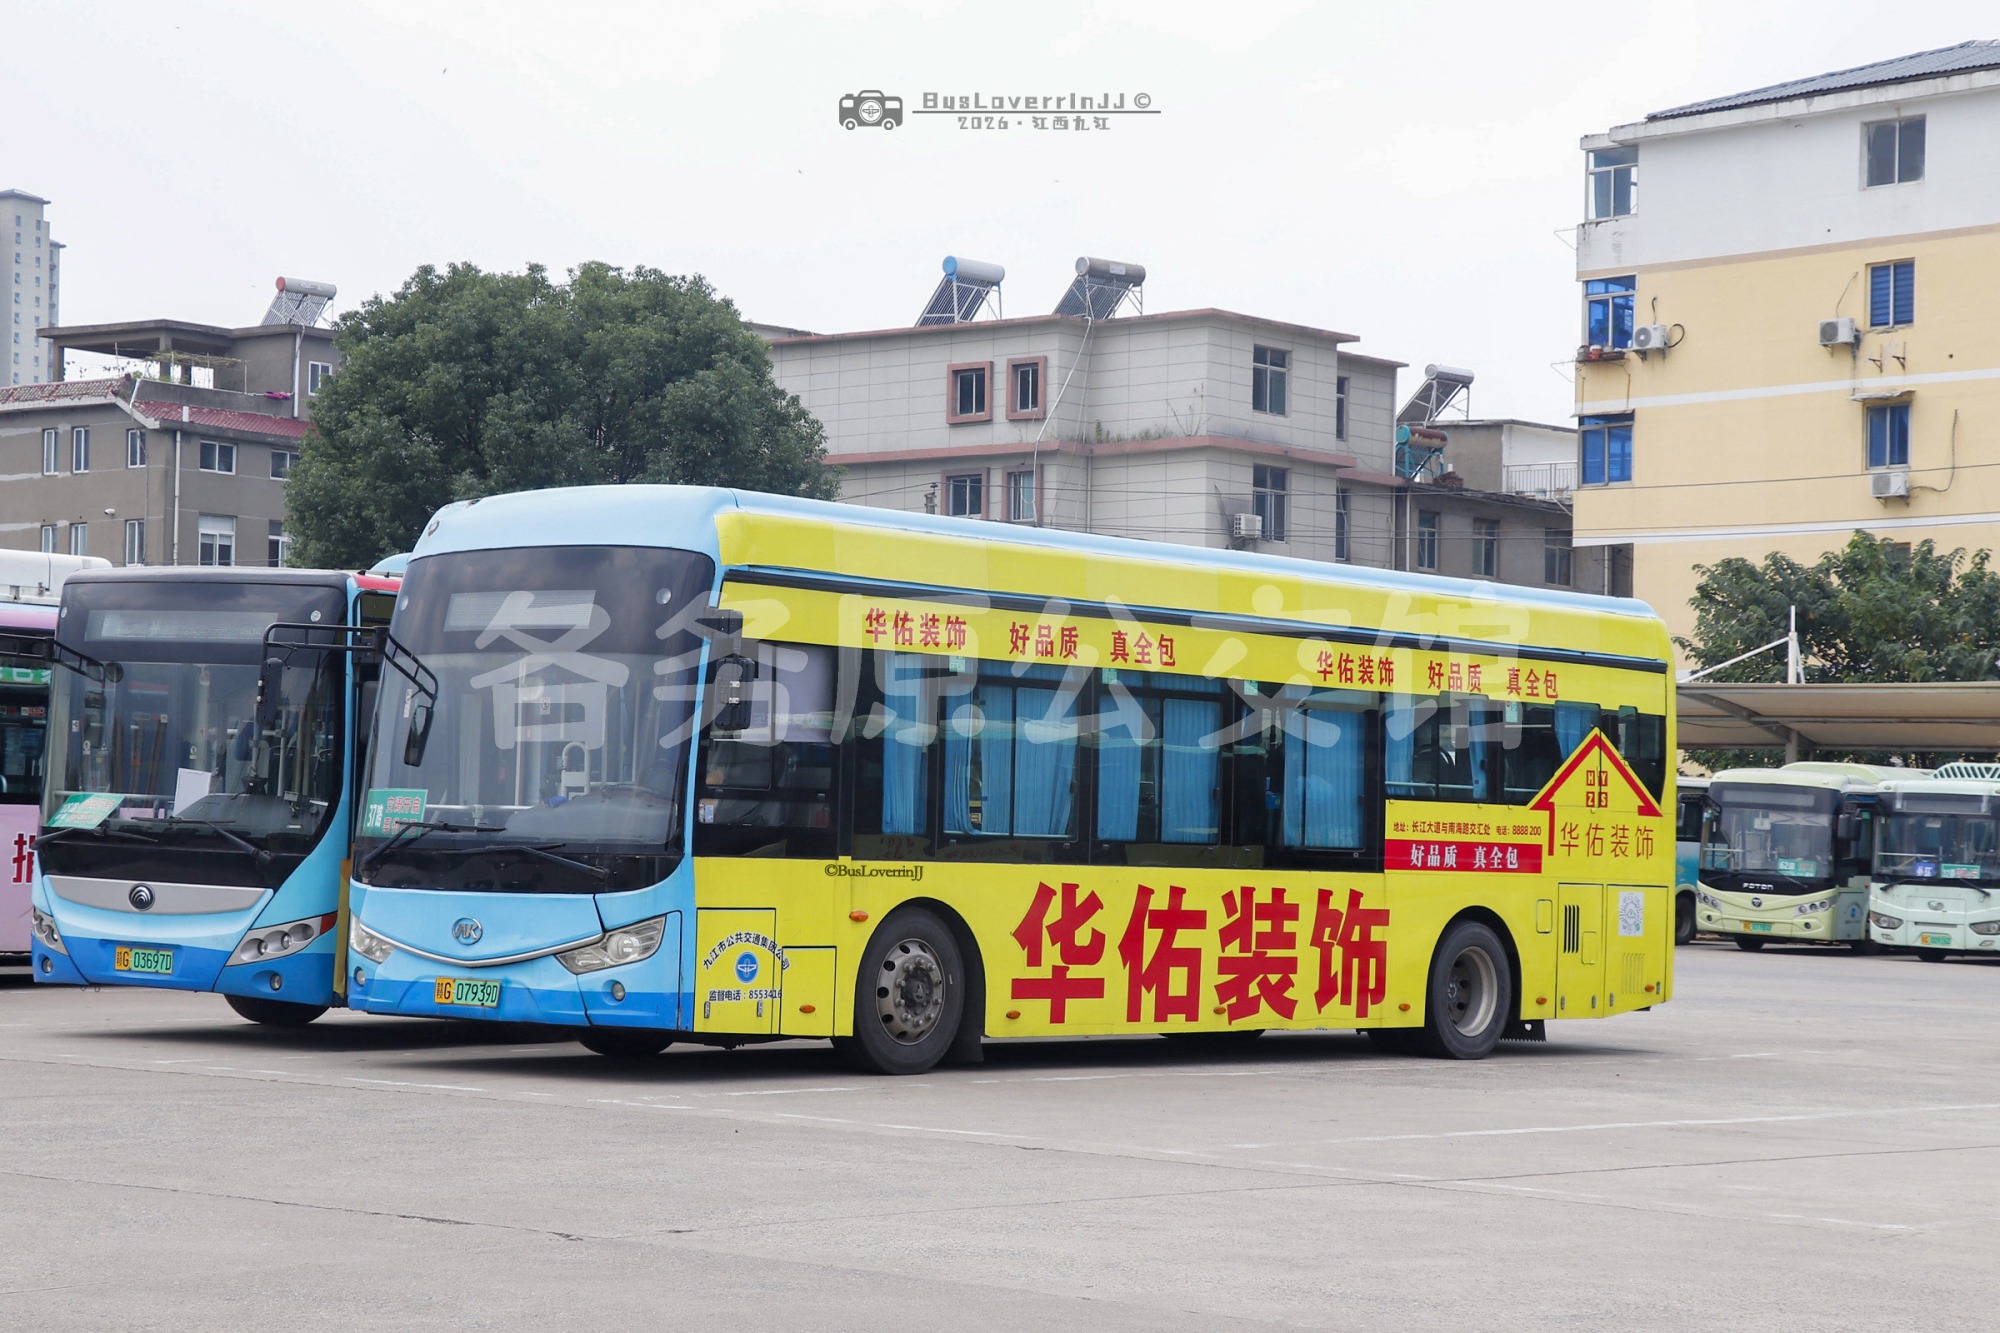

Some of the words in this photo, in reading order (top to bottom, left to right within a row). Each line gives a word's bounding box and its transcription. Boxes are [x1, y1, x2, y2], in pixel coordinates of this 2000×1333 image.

[865, 607, 967, 650] 华佑装饰
[1009, 621, 1079, 660] 好品质
[1110, 629, 1176, 667] 真全包
[1317, 650, 1395, 688] 华佑装饰
[1428, 660, 1482, 693] 好品质
[1507, 667, 1559, 699] 真全包
[1410, 843, 1458, 868] 好品质
[1473, 845, 1519, 869] 真全包
[1560, 822, 1654, 860] 华佑装饰
[703, 931, 790, 971] 九江市公共交通集团公司
[1010, 881, 1391, 1026] 华佑装饰
